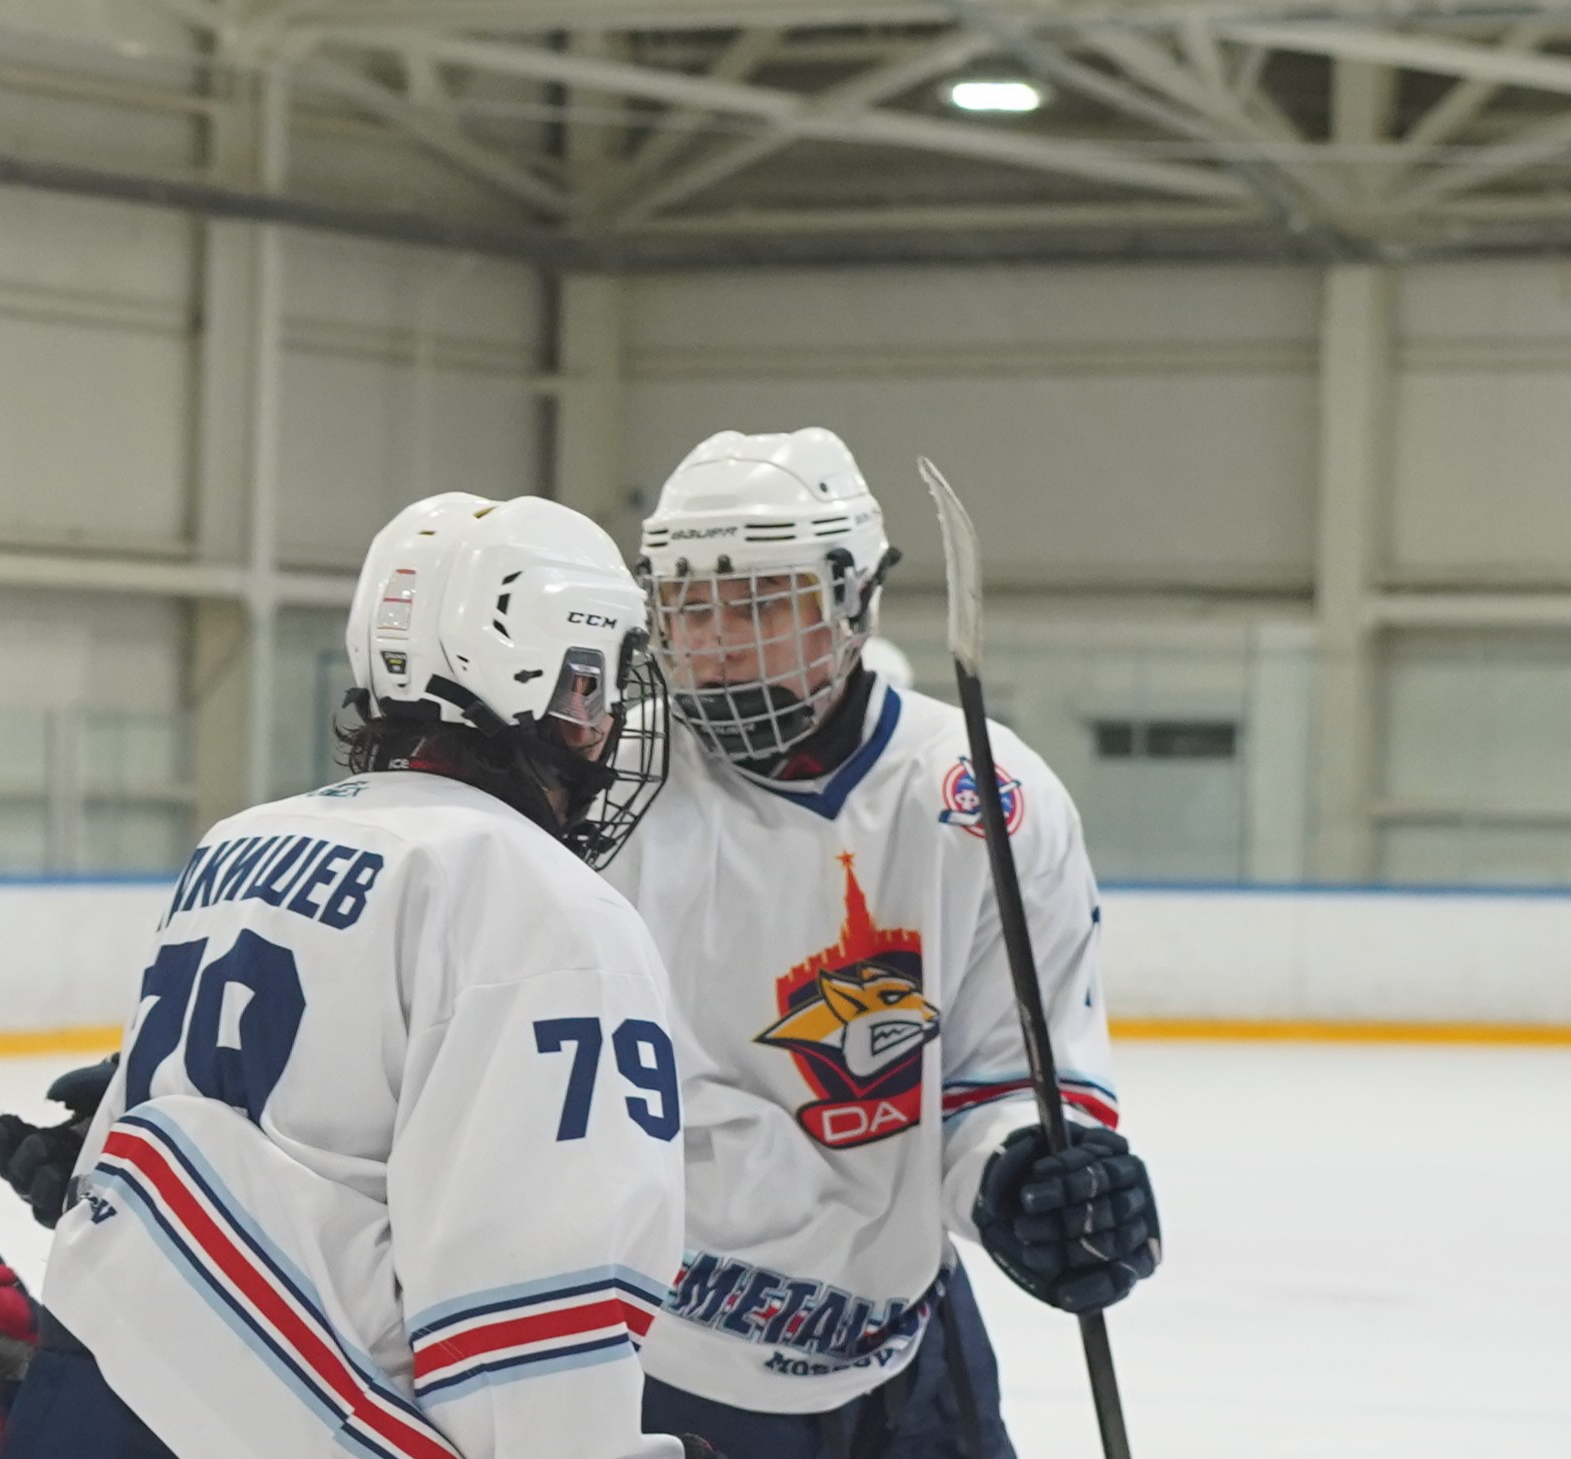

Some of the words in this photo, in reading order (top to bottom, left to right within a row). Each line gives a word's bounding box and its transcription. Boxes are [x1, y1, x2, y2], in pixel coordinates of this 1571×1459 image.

[568, 610, 617, 630] CCM
[533, 1017, 682, 1143] 79
[821, 1102, 908, 1143] DA
